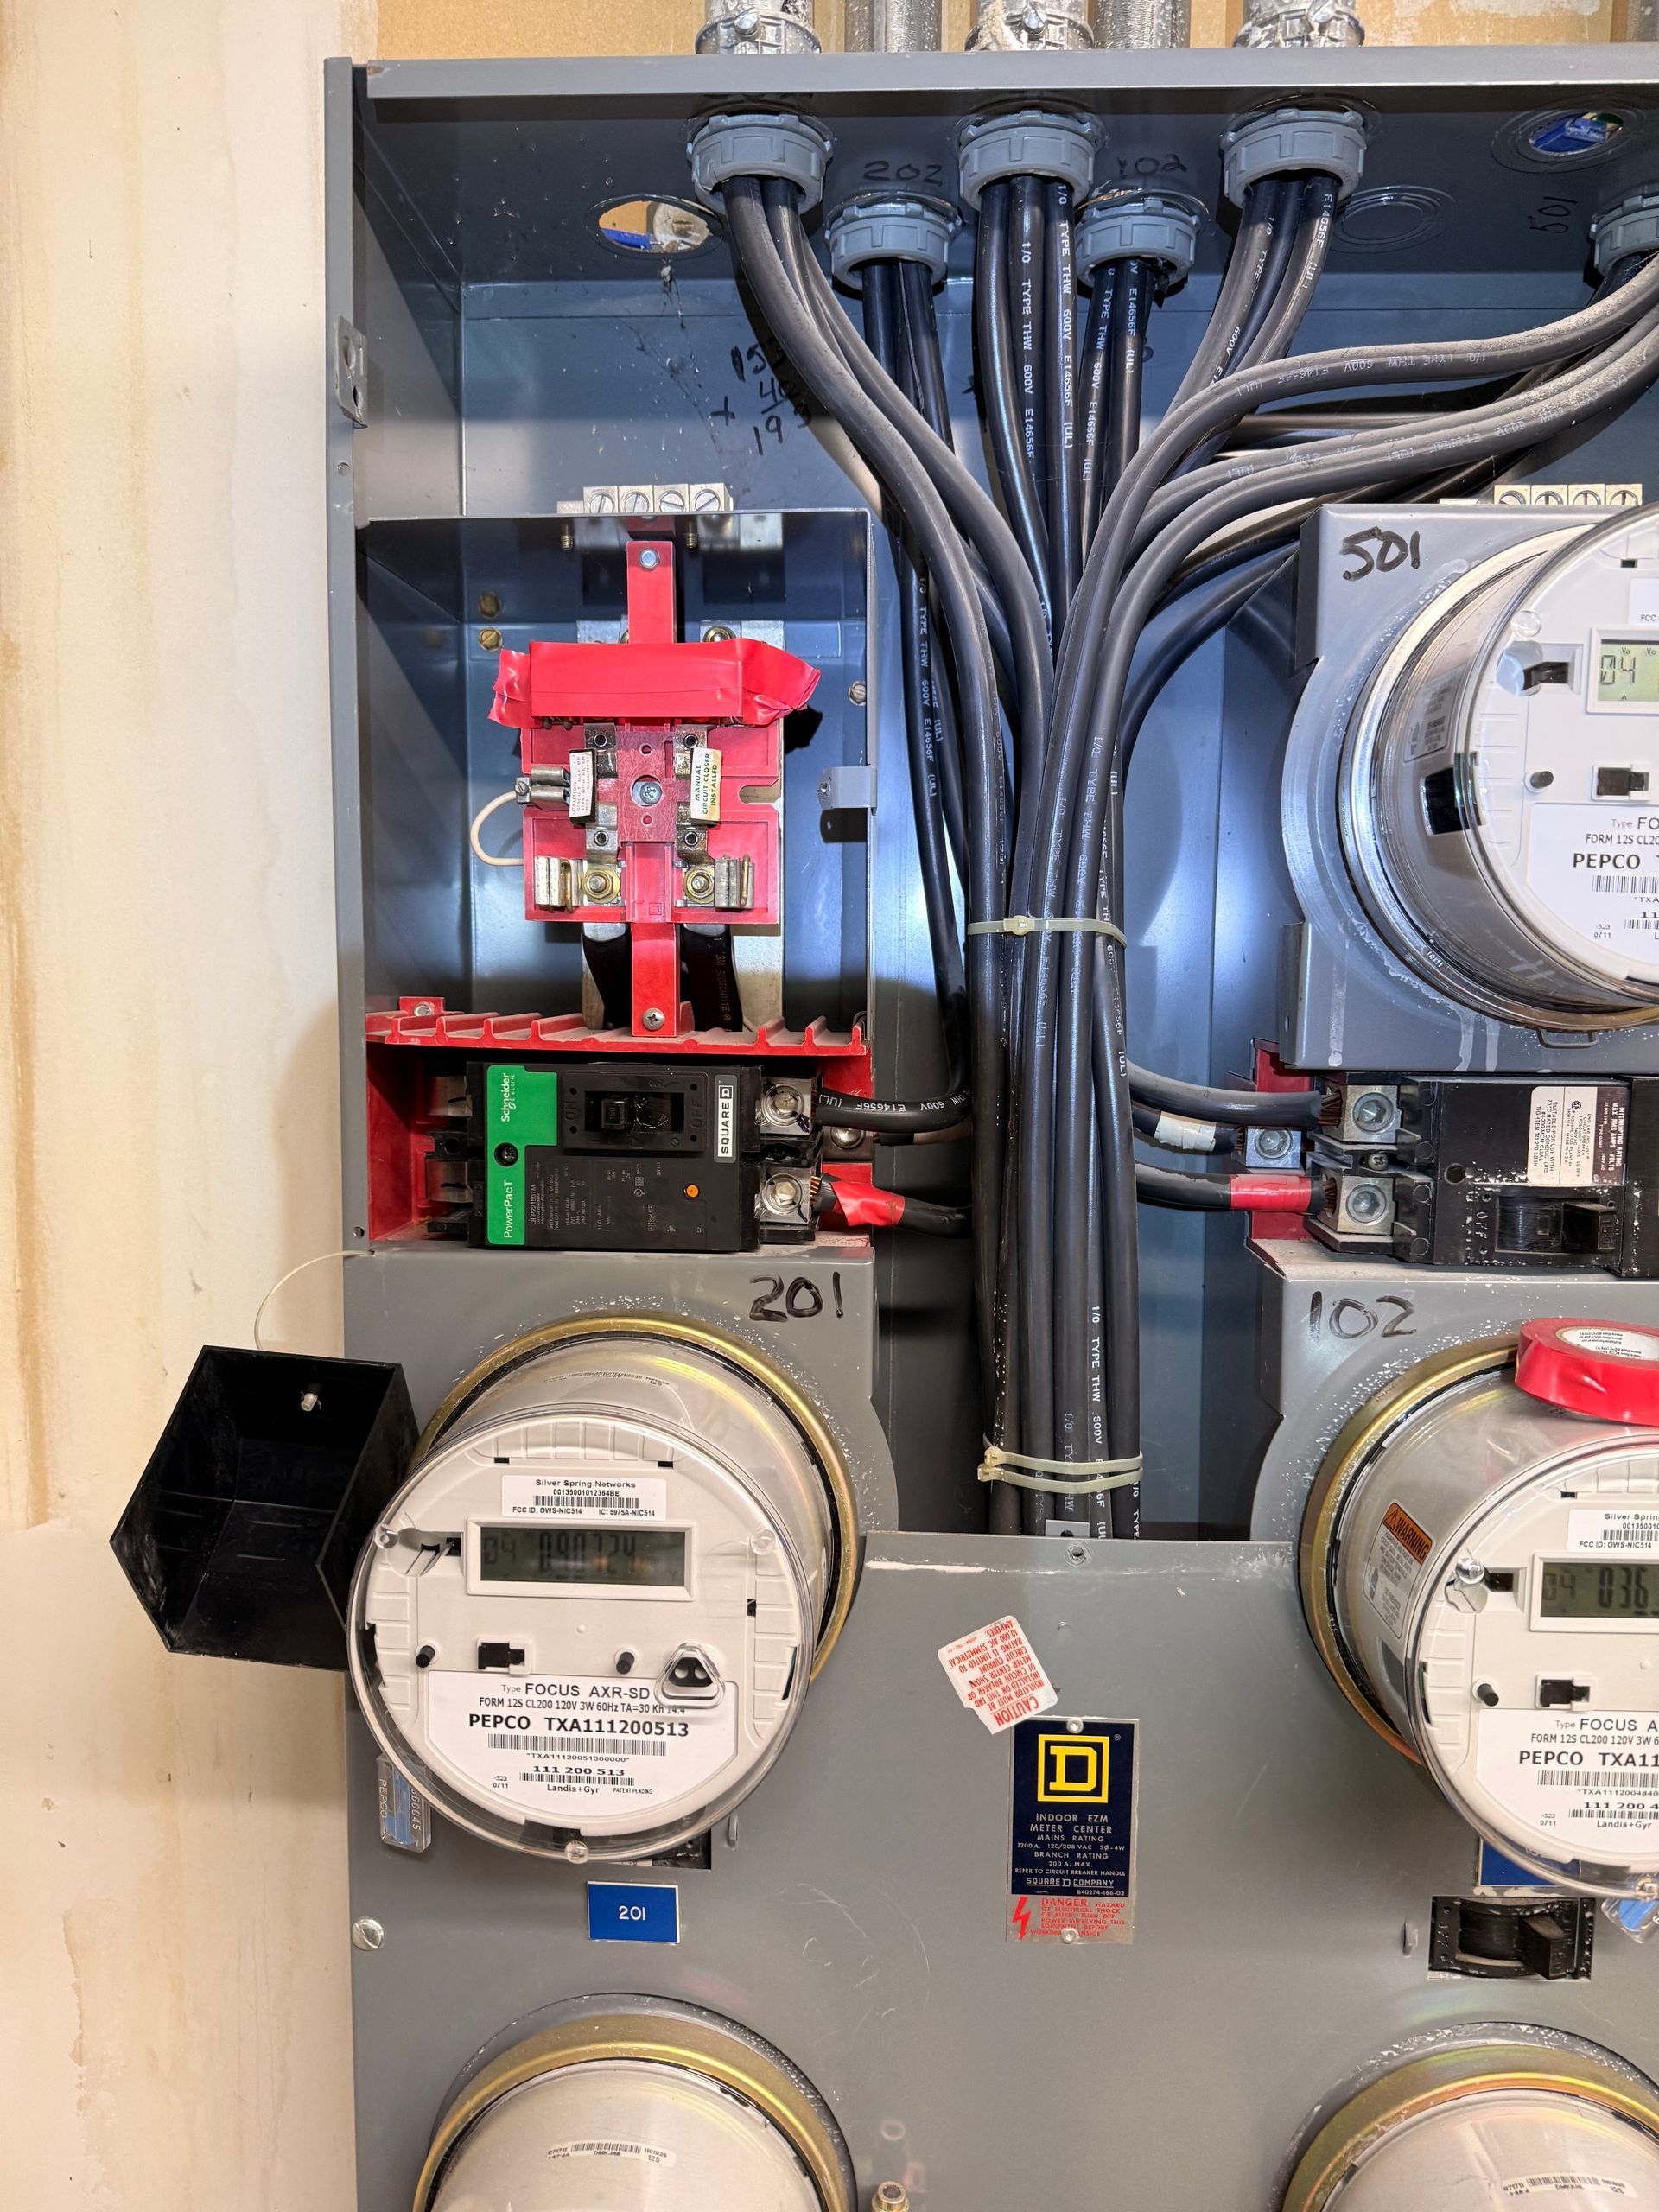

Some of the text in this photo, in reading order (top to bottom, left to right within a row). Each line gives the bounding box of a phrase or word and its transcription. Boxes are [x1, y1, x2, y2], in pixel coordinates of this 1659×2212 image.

[864, 160, 944, 184] 202
[1057, 184, 1074, 448] 1/0 TYPE THW 600V E14656F (UL)
[1100, 288, 1114, 319] TYPE
[1127, 287, 1138, 337] E14656F
[1021, 242, 1035, 459] 1/0 TYPE THW 600V E14656F
[1096, 325, 1108, 351] THW
[1226, 326, 1241, 358] 600V
[1125, 349, 1135, 374] (UL)
[1344, 358, 1374, 372] 600V
[1091, 362, 1103, 390] 600V
[1085, 401, 1098, 446] E14656F
[1082, 458, 1093, 481] (UL)
[1338, 527, 1421, 581] 501
[918, 605, 928, 635] TYPE
[919, 640, 929, 668] THW
[1600, 655, 1636, 685] 04
[921, 679, 930, 707] 600V
[924, 717, 935, 763] E14656F
[1081, 768, 1099, 840] TYPE THW
[1611, 818, 1633, 828] Type
[1586, 833, 1634, 845] FORM 12S
[1573, 852, 1641, 870] PEPCO
[1098, 867, 1127, 1077] TYPE (UL)
[500, 1072, 511, 1122] Schneider
[855, 1100, 945, 1113] 600V E14656F
[721, 1101, 730, 1154] SQUARE
[504, 1179, 514, 1238] PowerPacT
[748, 1271, 845, 1321] 201
[1307, 1291, 1418, 1343] 102
[1091, 1306, 1103, 1445] 1/0 TYPE THW 600V
[563, 1479, 592, 1488] Spring
[1394, 1510, 1429, 1560] WARNING
[958, 1637, 1023, 1674] RATING LIMITED TO
[978, 1645, 1027, 1674] CIRCUIT CURRENT
[990, 1654, 1032, 1679] METER CENTER
[500, 1683, 651, 1700] Type FOCUS AXR-SD
[975, 1670, 1040, 1707] INSTALLED THIS END
[978, 1662, 1036, 1695] OF CIRCUIT BREAKER
[479, 1696, 650, 1713] FORM 12S CL200 120V 3W 60Hz TA=30
[987, 1680, 1045, 1712] INSULATOR MUST BE
[993, 1695, 1039, 1726] CAUTION
[468, 1713, 690, 1738] PEPCO TXA111200513
[1530, 1733, 1652, 1745] FORM 12S CL200 120V 3W
[1555, 1718, 1637, 1732] Type FOCUS
[565, 1766, 593, 1775] 200
[1518, 1750, 1584, 1765] PEPCO
[379, 1778, 388, 1819] PEPCO
[547, 1784, 600, 1795] Landis+Gyr
[1029, 1823, 1112, 1834] METER CENTER
[1036, 1813, 1078, 1822] INDOOR
[1597, 1821, 1653, 1830] Landis+Gyr
[1026, 1877, 1115, 1887] SQUARE COMPANY
[618, 1904, 646, 1921] 201
[1041, 1897, 1088, 1907] DANGER
